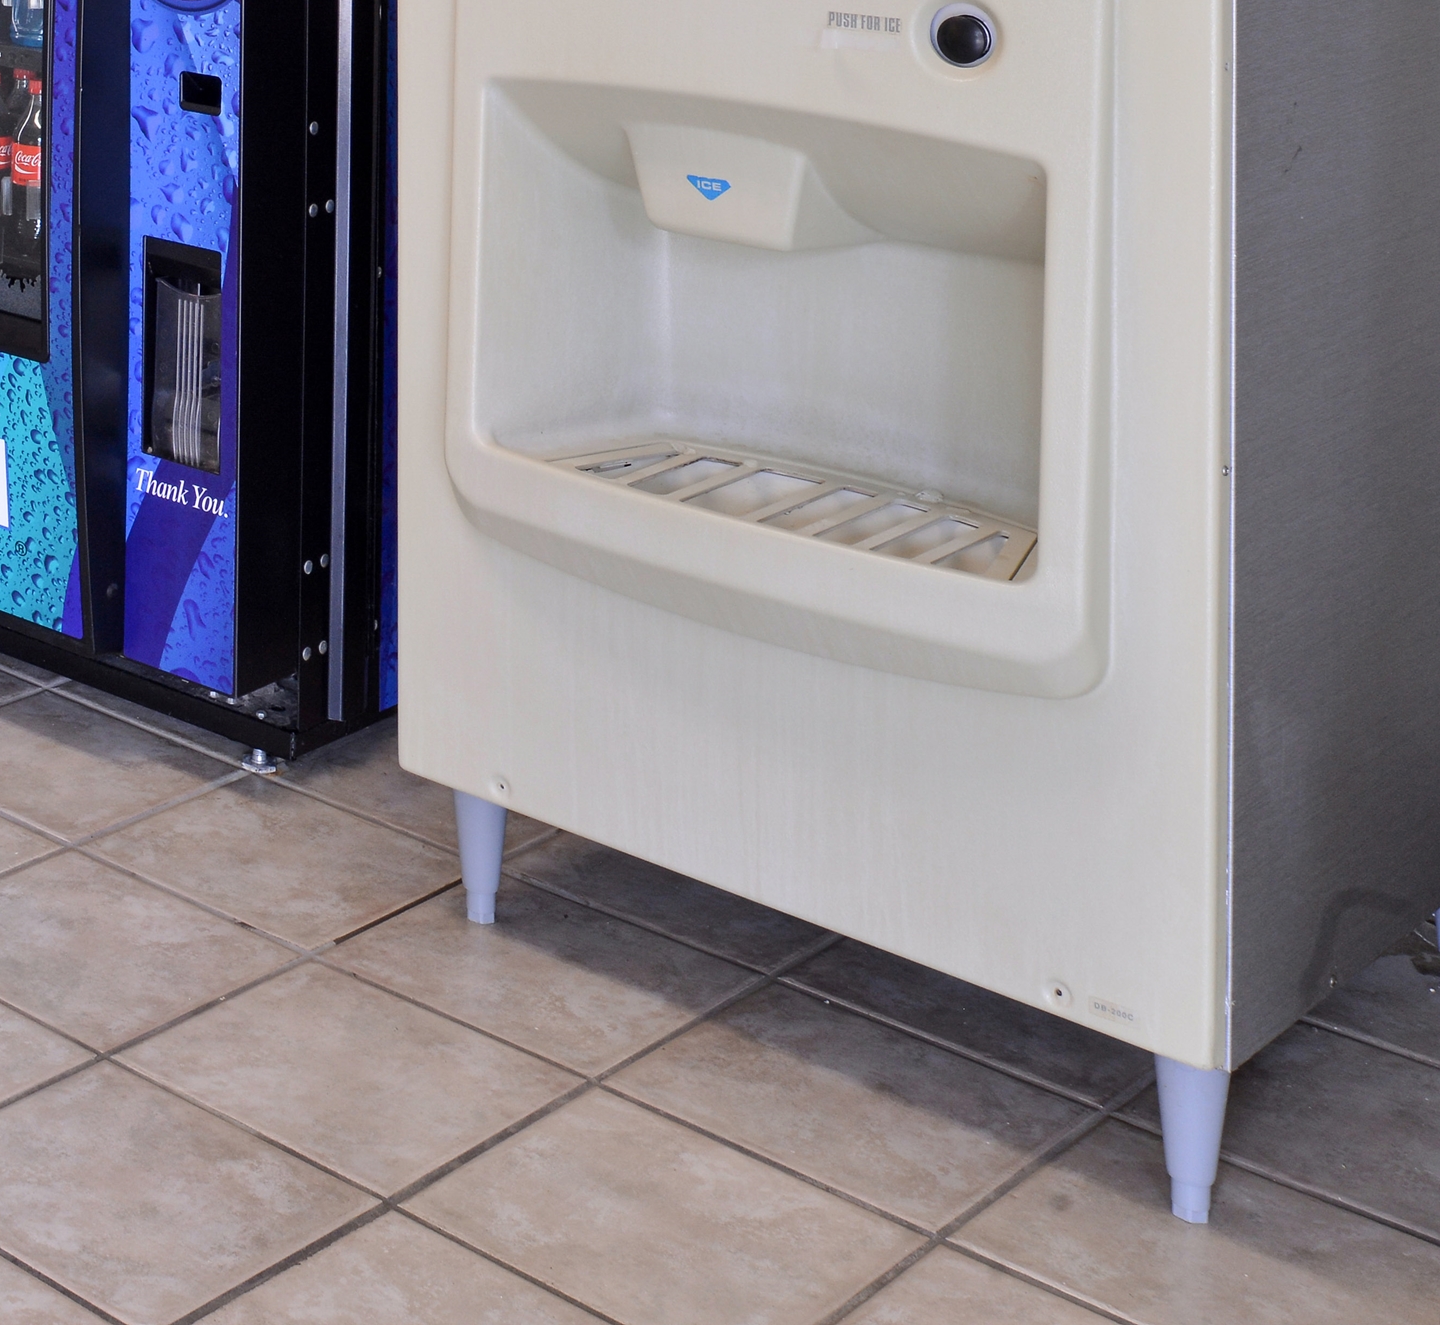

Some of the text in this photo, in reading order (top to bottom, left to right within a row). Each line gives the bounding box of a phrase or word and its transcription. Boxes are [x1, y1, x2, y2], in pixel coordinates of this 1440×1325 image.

[828, 11, 901, 33] PUSH FOR ICE
[697, 179, 722, 192] ICE
[135, 467, 228, 519] Thank You.
